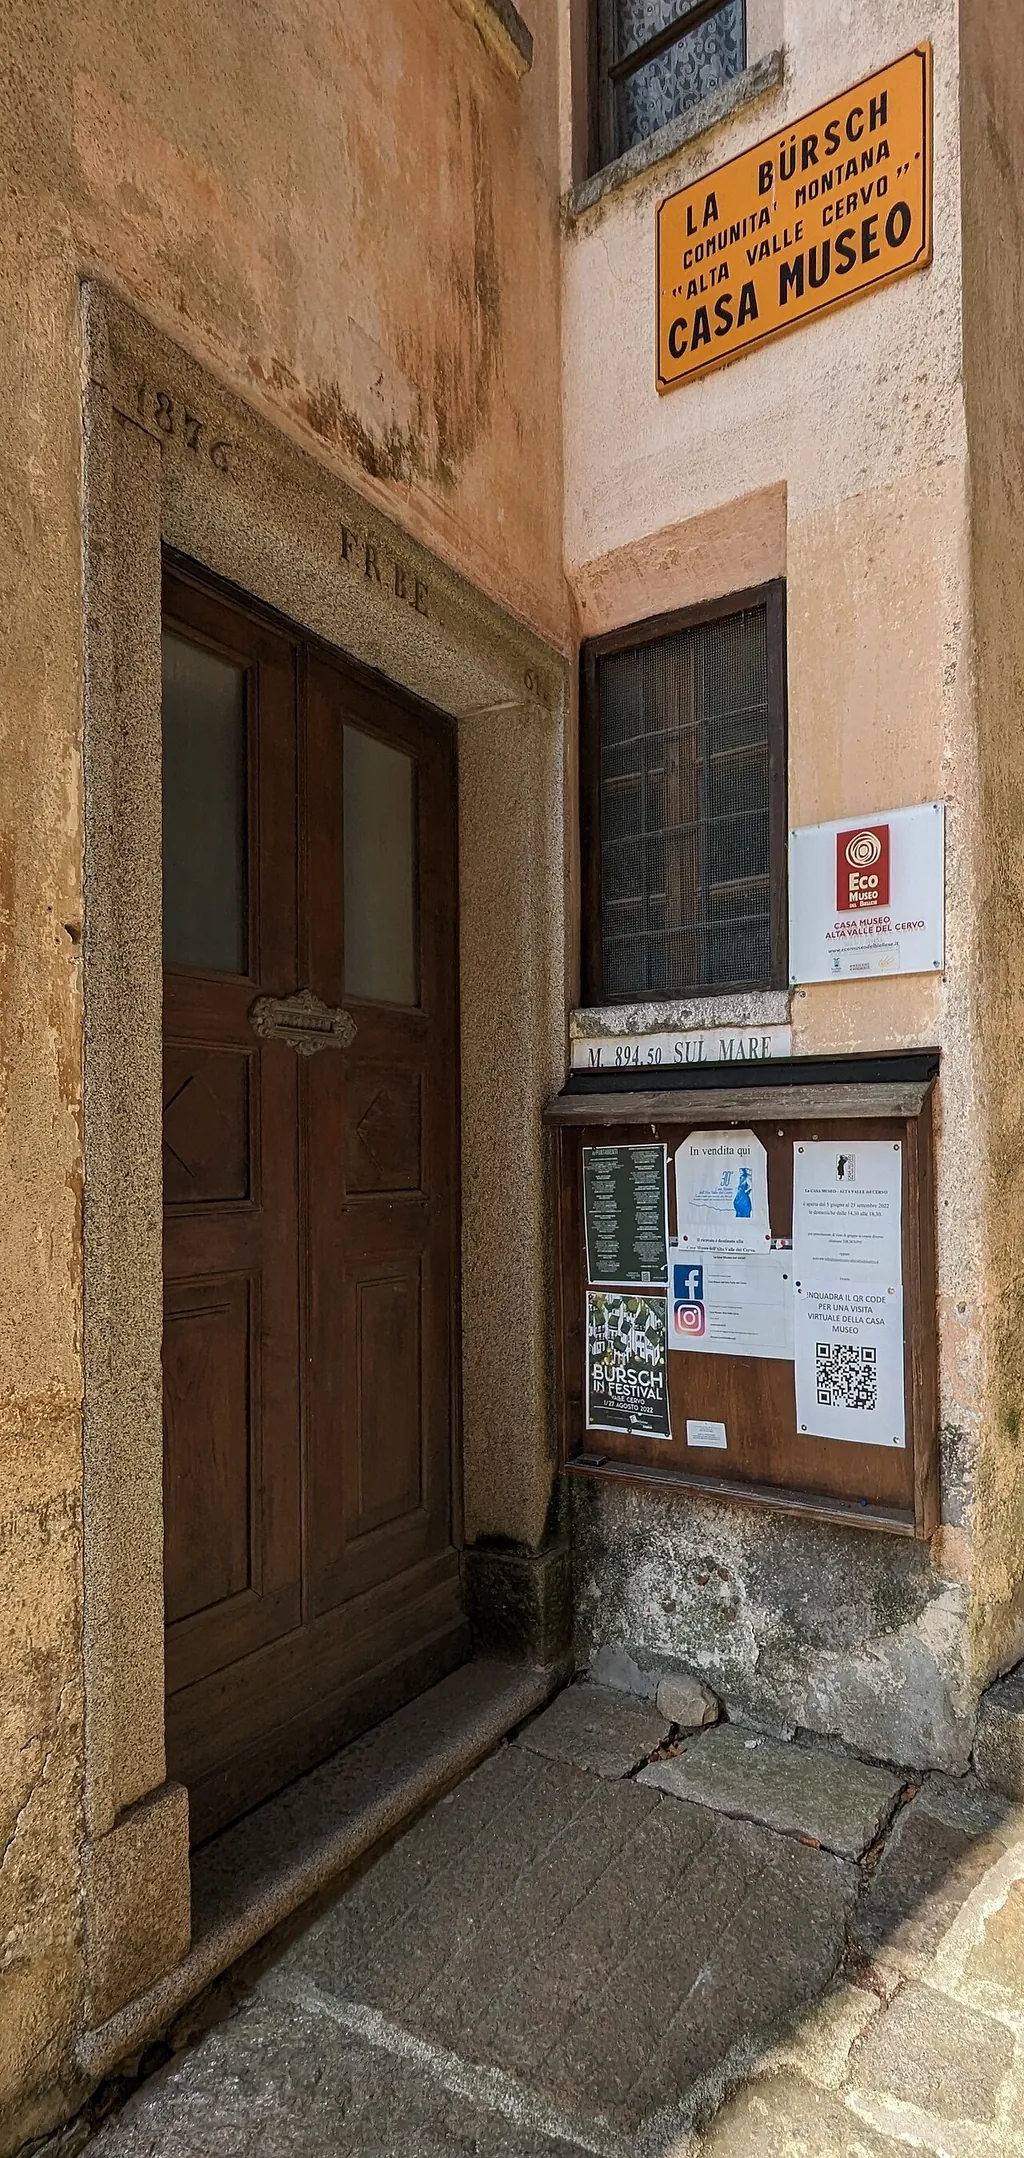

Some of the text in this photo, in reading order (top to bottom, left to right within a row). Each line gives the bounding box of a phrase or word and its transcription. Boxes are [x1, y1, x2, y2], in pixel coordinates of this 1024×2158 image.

[686, 90, 888, 237] LA BÜRSCH
[795, 139, 890, 209] MONTANA
[746, 220, 803, 267] VALLE
[668, 200, 912, 359] CASA MUSEO
[825, 920, 925, 939] ALTA VALLE DEL CERVO
[833, 915, 891, 930] CASA MUSEO
[673, 1040, 707, 1064] SUL
[718, 1036, 772, 1061] MARE
[690, 1145, 751, 1157] In vendita qui
[806, 1291, 844, 1301] INQUADRA
[853, 1294, 864, 1302] QR
[865, 1295, 886, 1304] CODE
[818, 1302, 873, 1314] PER UNA VISITA
[807, 1312, 886, 1325] VIRTUALE DELLA CASA
[831, 1325, 859, 1334] MUSEO
[593, 1379, 663, 1400] IN FESTIVAL
[616, 1402, 639, 1411] AGOSTO
[640, 1405, 654, 1413] 2022
[626, 1396, 645, 1405] CERVO
